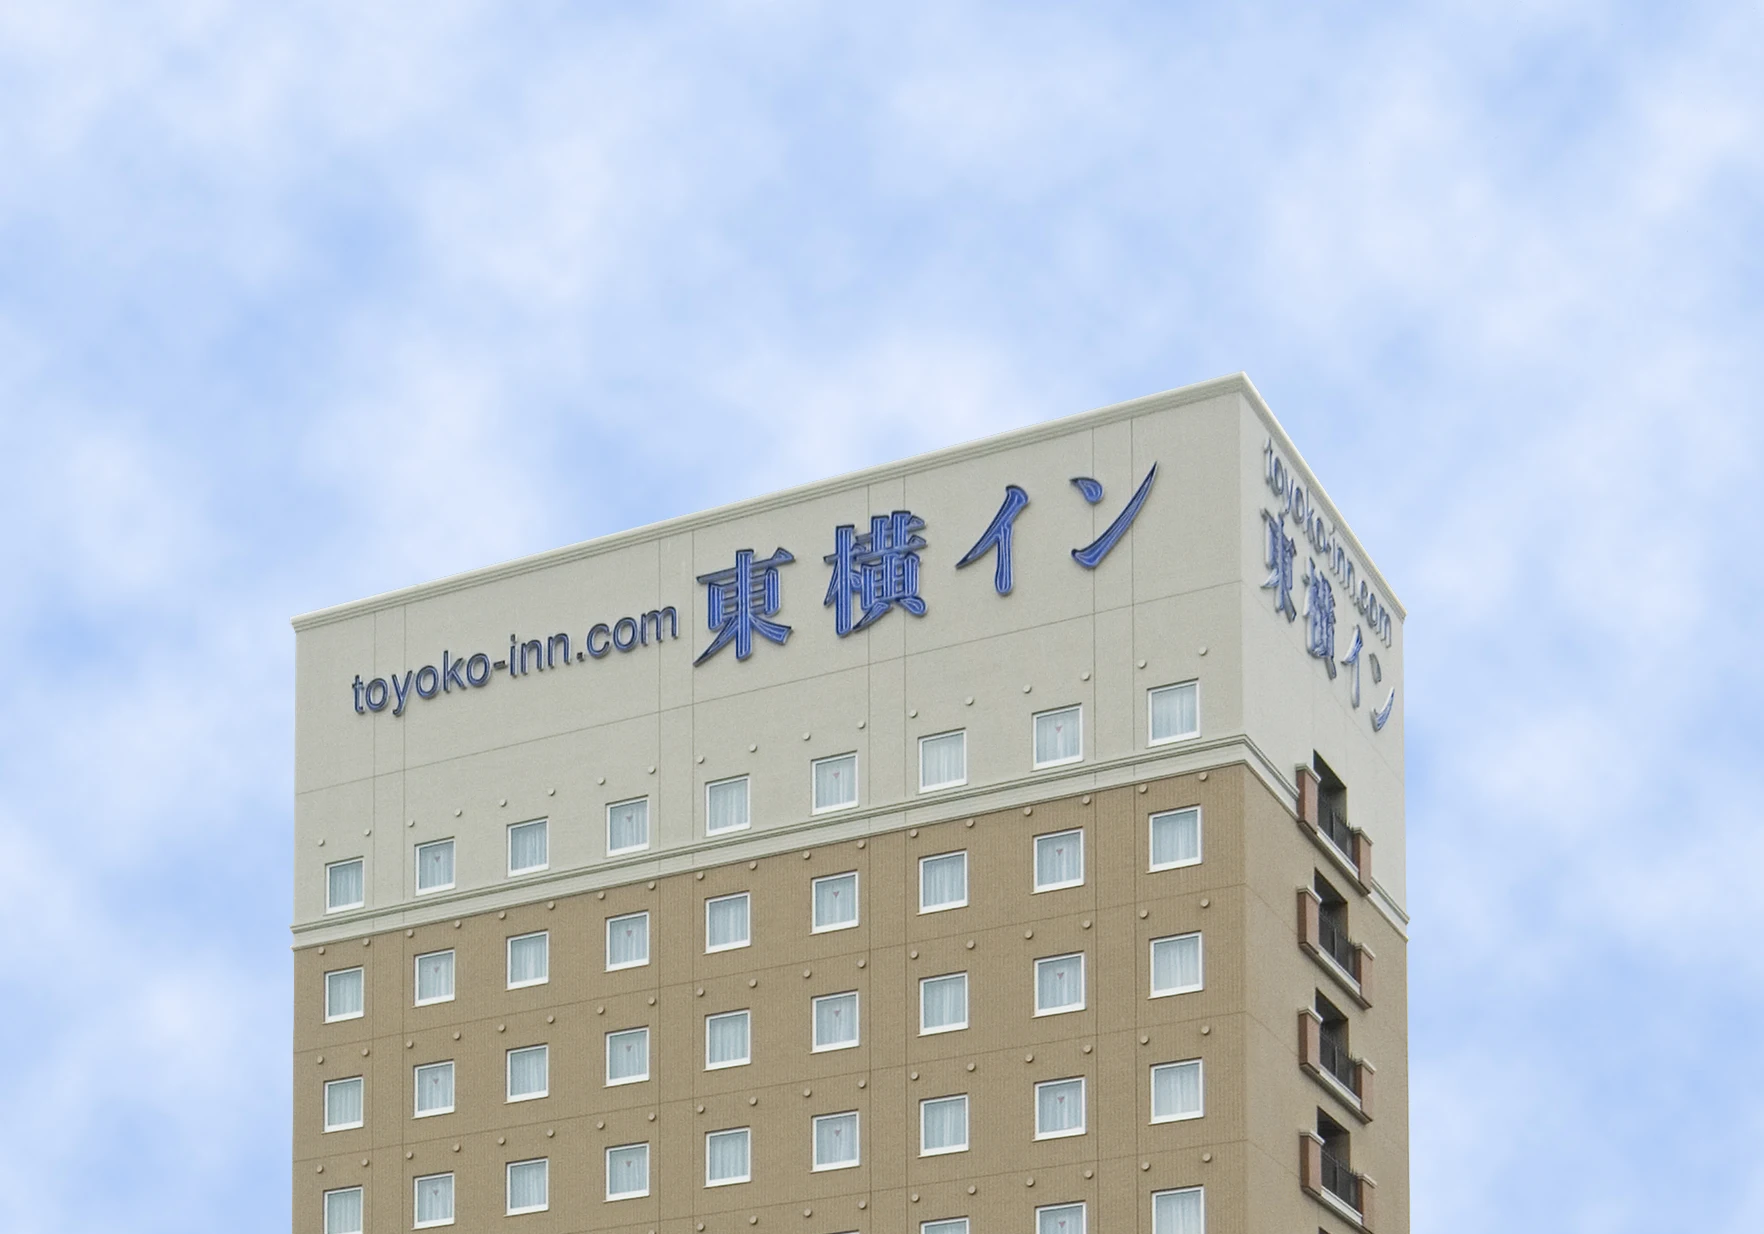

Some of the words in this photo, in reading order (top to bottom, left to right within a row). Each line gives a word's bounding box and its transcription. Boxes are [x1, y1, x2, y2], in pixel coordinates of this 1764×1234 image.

[691, 460, 1159, 667] 東横イン
[1259, 506, 1396, 734] 東横イン
[1264, 436, 1392, 649] toyoko-inn.com
[352, 603, 679, 716] toyoko-inn.com
